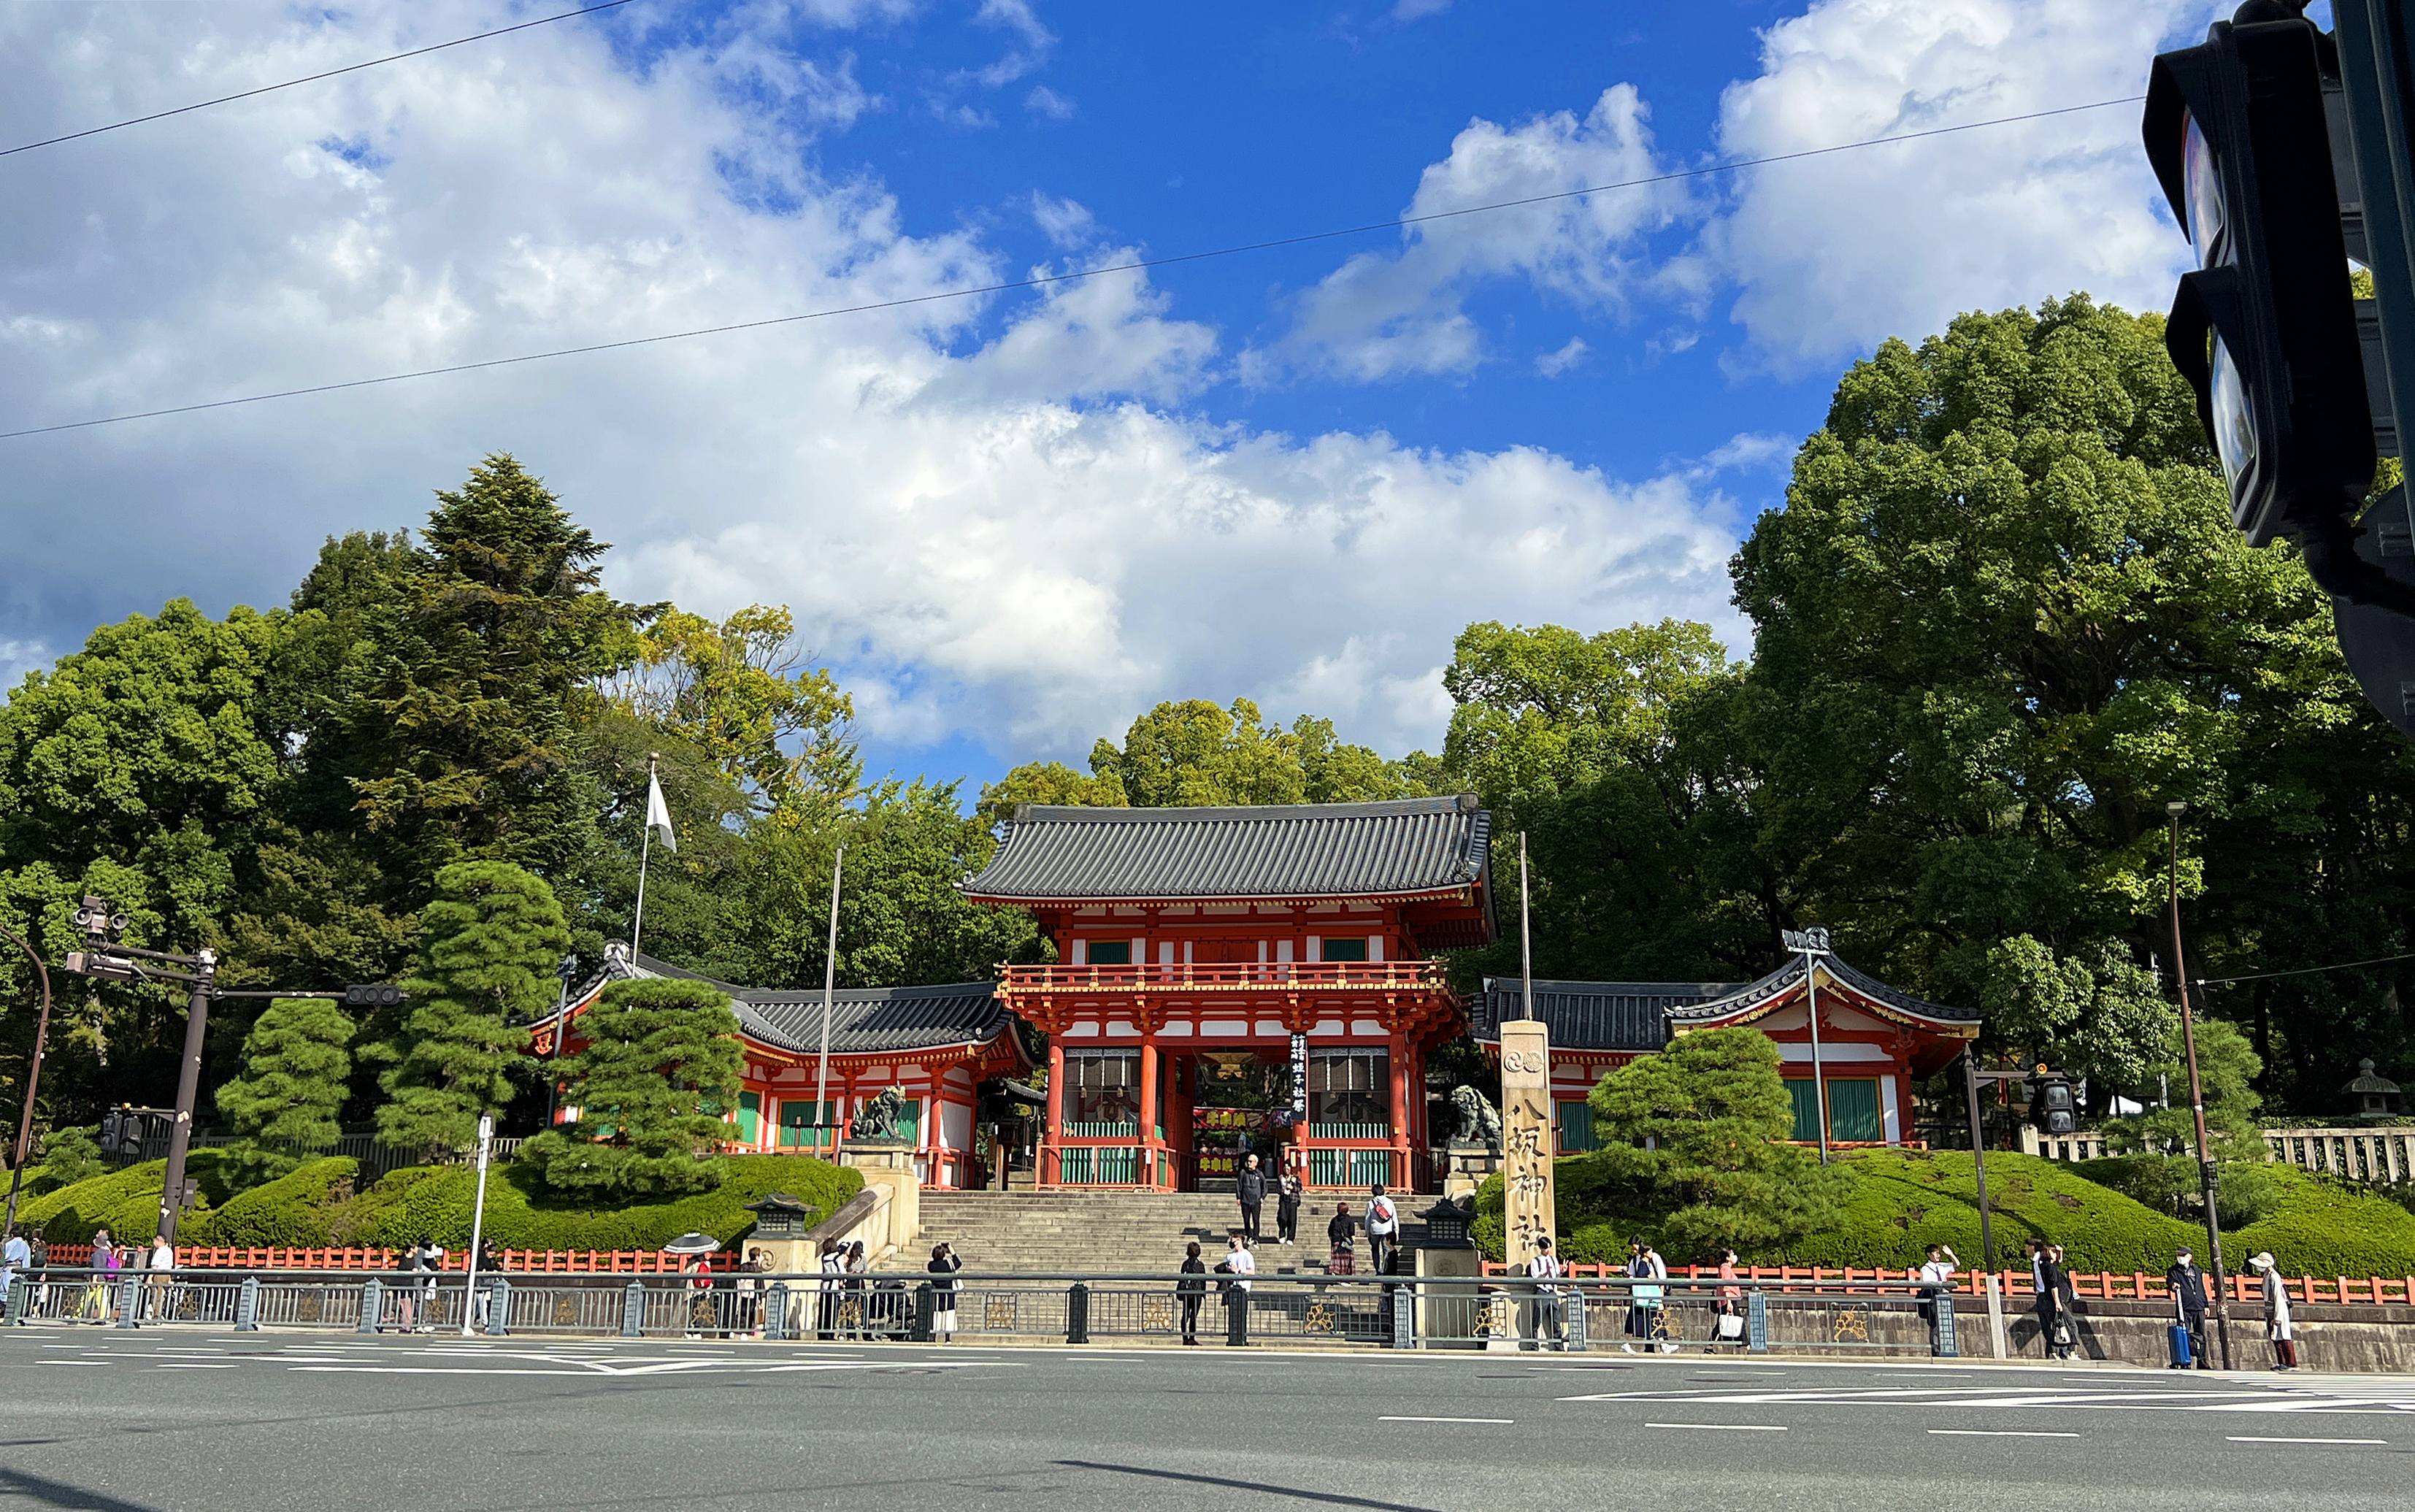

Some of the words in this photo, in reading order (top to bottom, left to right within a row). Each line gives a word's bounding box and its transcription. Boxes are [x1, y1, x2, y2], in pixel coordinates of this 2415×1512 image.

[1292, 1062, 1306, 1113] 蛭子社祭
[1505, 1098, 1547, 1251] 八坂神社
